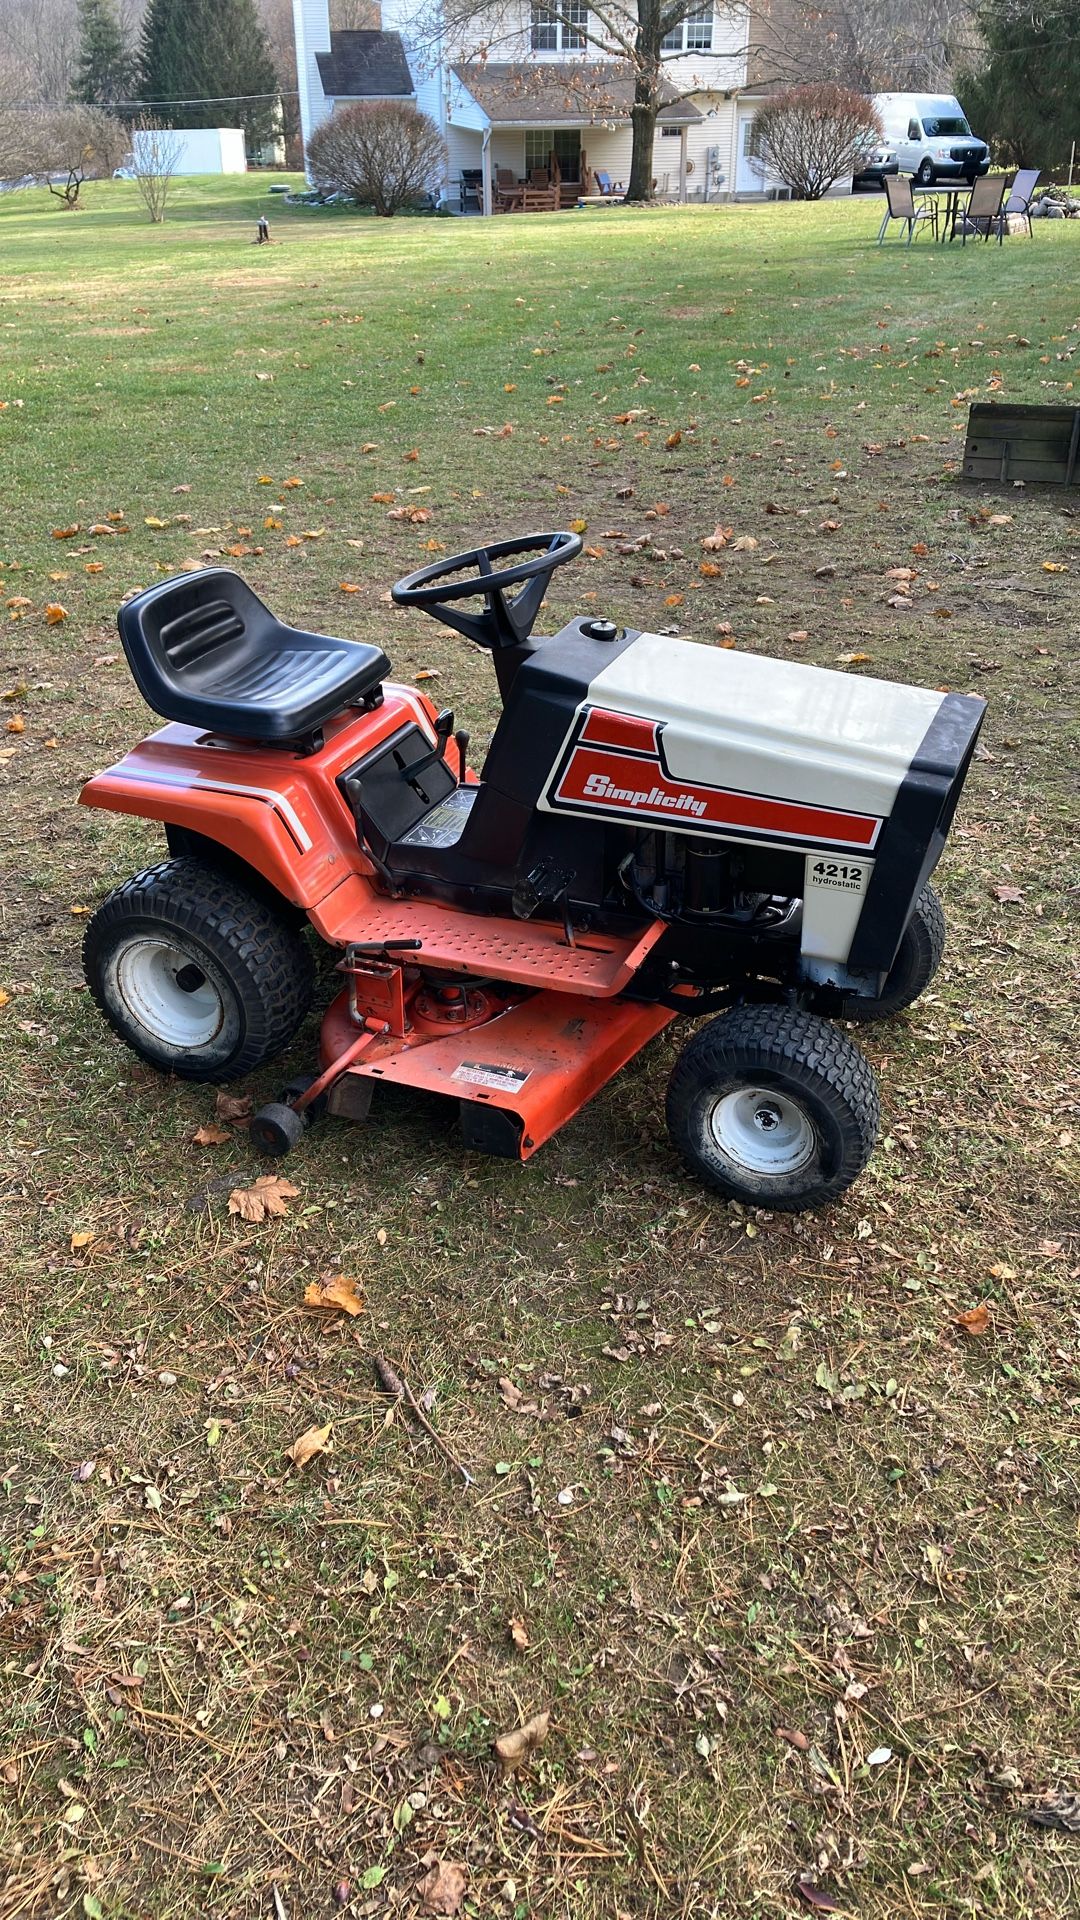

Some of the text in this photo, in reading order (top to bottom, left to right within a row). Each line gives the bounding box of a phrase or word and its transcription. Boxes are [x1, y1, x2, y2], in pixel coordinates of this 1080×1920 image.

[583, 774, 707, 816] Simplicity
[813, 862, 862, 881] 4212
[812, 875, 861, 890] hydrostatic
